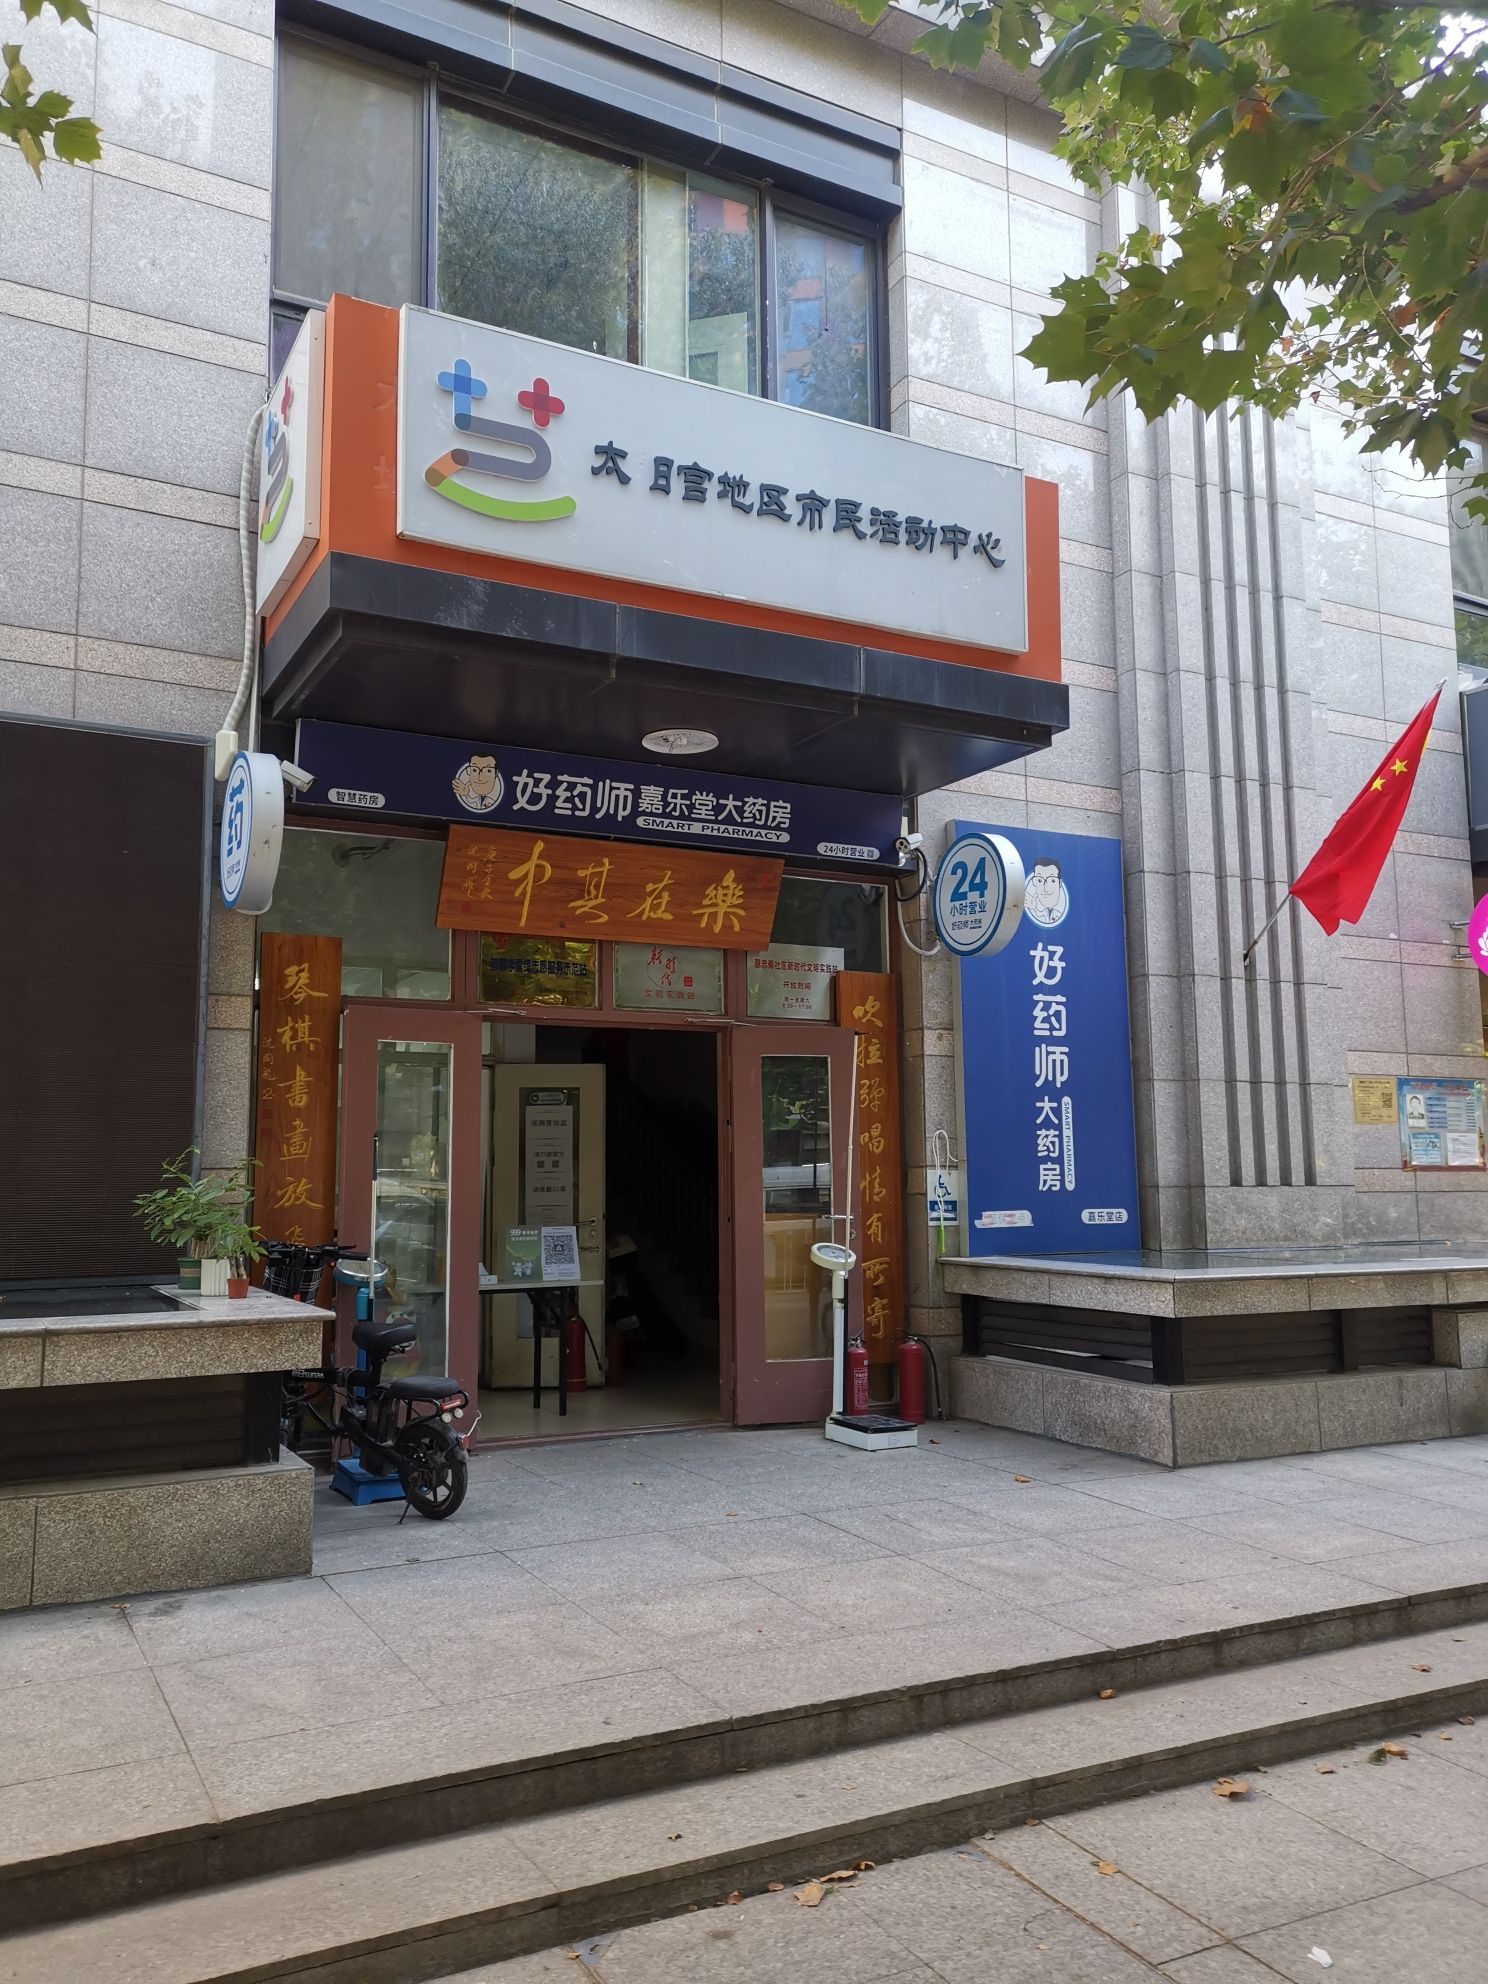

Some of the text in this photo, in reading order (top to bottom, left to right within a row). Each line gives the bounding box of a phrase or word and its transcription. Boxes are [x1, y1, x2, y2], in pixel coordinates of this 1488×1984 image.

[335, 790, 381, 807] 智慧药房
[511, 768, 792, 829] 好药师 嘉乐堂大药房
[642, 817, 783, 841] SMART PHARMACY
[949, 856, 988, 903] 24
[949, 900, 988, 917] 小时营业
[1029, 942, 1069, 1192] 好药师 大药房
[1063, 1101, 1075, 1186] SMART PHARMACY
[1087, 1211, 1124, 1222] 嘉乐堂店
